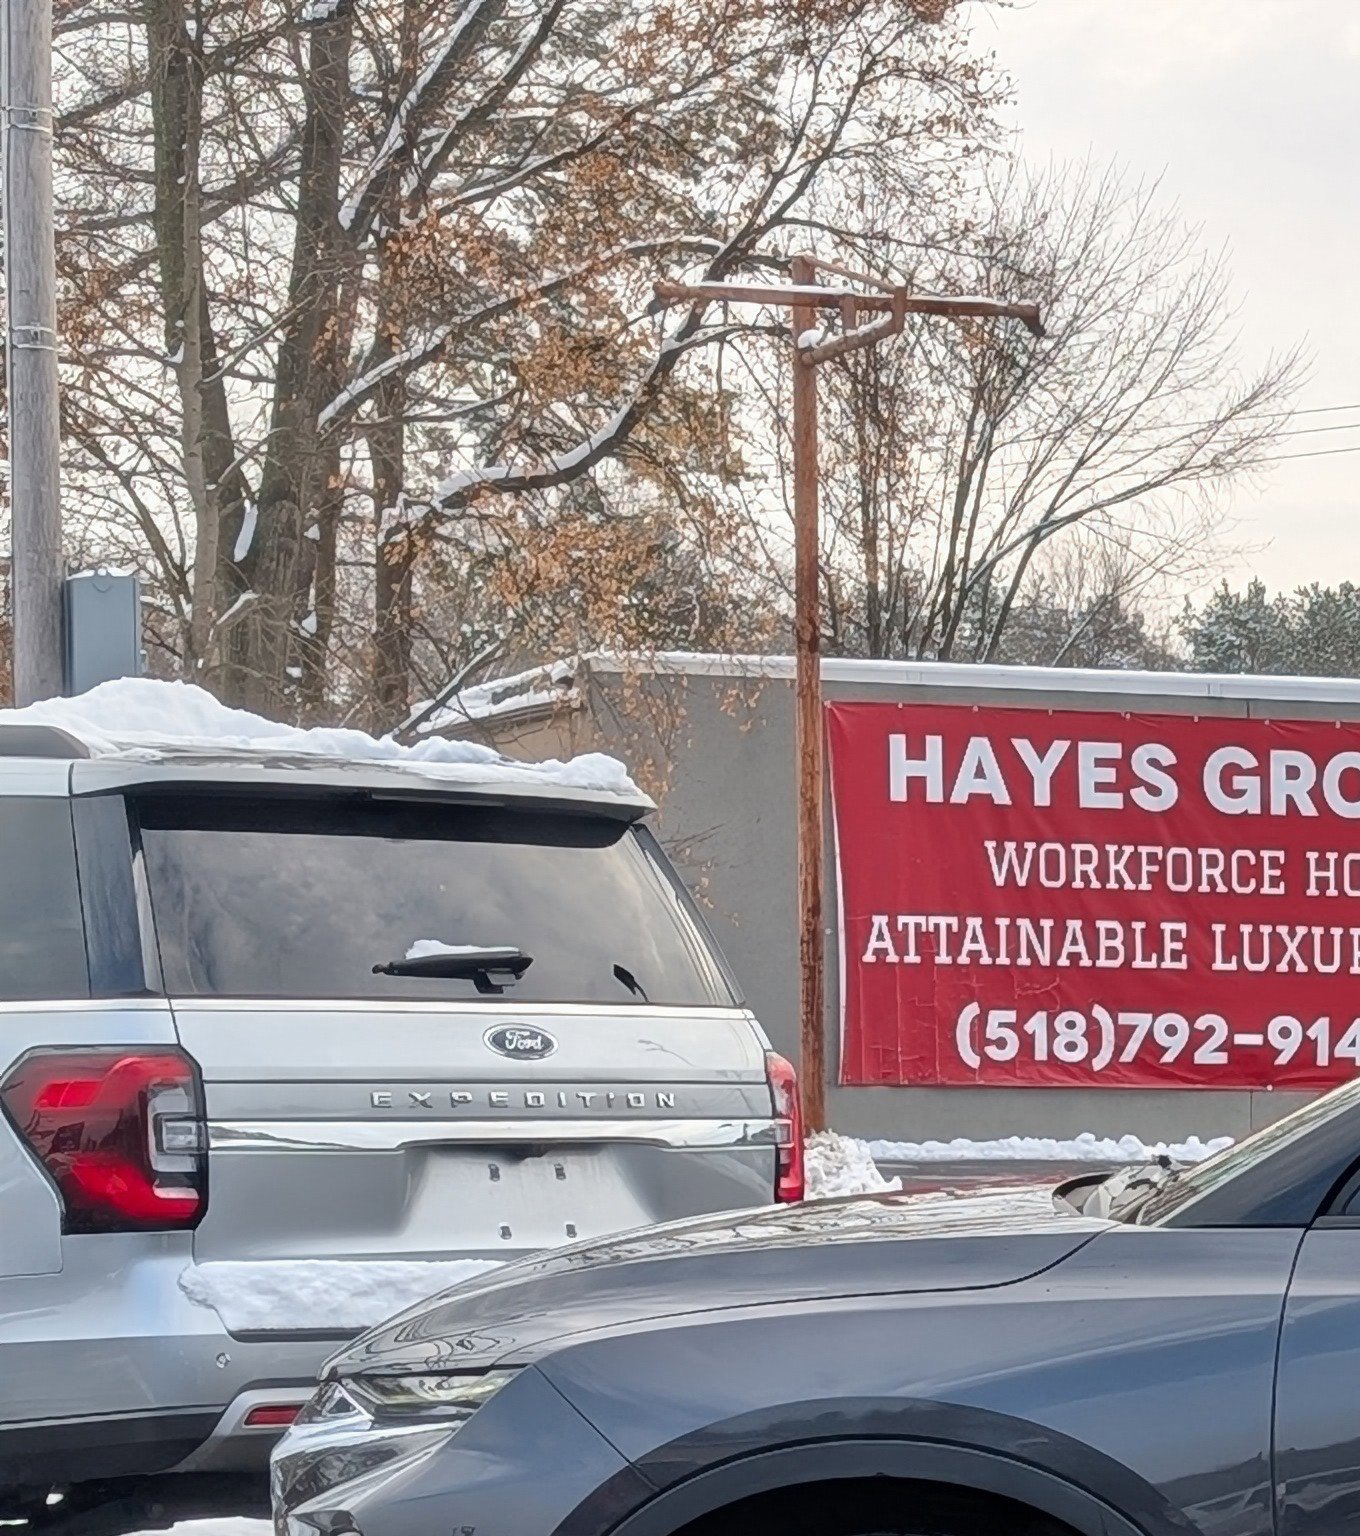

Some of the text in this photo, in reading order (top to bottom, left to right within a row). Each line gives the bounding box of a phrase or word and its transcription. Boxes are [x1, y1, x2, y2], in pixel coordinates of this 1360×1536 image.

[888, 733, 1178, 812] HAYES
[984, 840, 1285, 895] WORKFORCE
[862, 914, 1188, 969] ATTAINABLE
[504, 1029, 543, 1050] Ford
[370, 1091, 676, 1109] EXPEDITION
